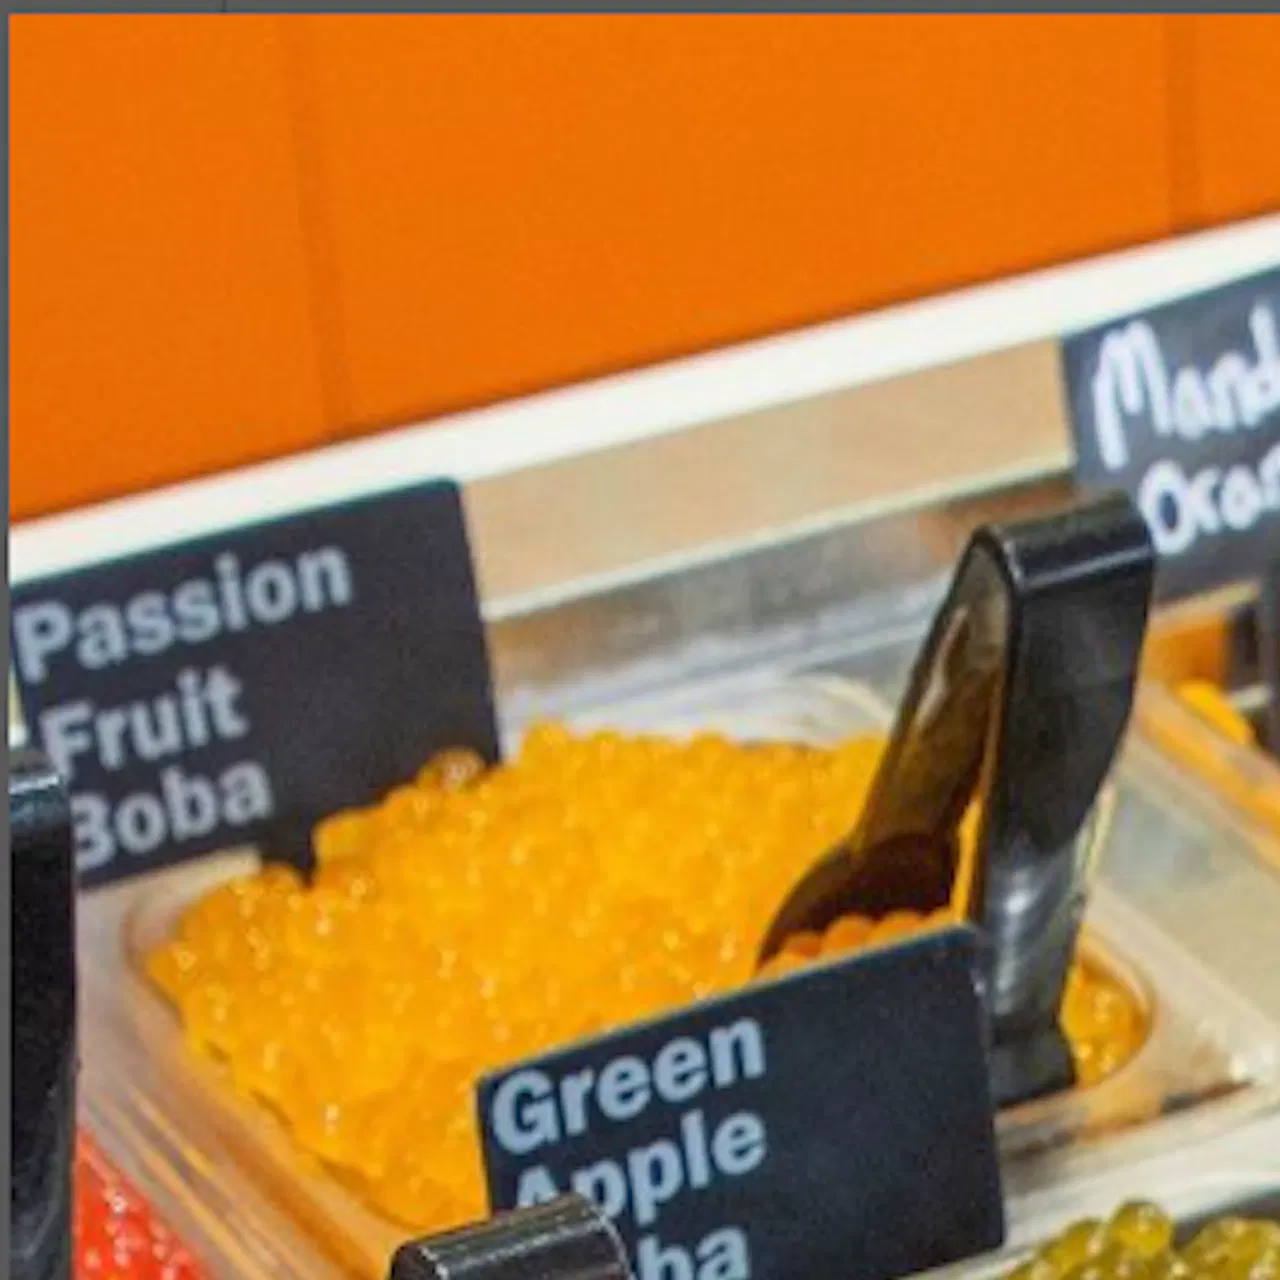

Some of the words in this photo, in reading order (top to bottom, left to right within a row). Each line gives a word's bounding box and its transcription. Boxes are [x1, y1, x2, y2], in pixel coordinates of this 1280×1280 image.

[14, 546, 354, 684] Passion
[39, 665, 249, 781] Fruit
[491, 1016, 767, 1156] Green
